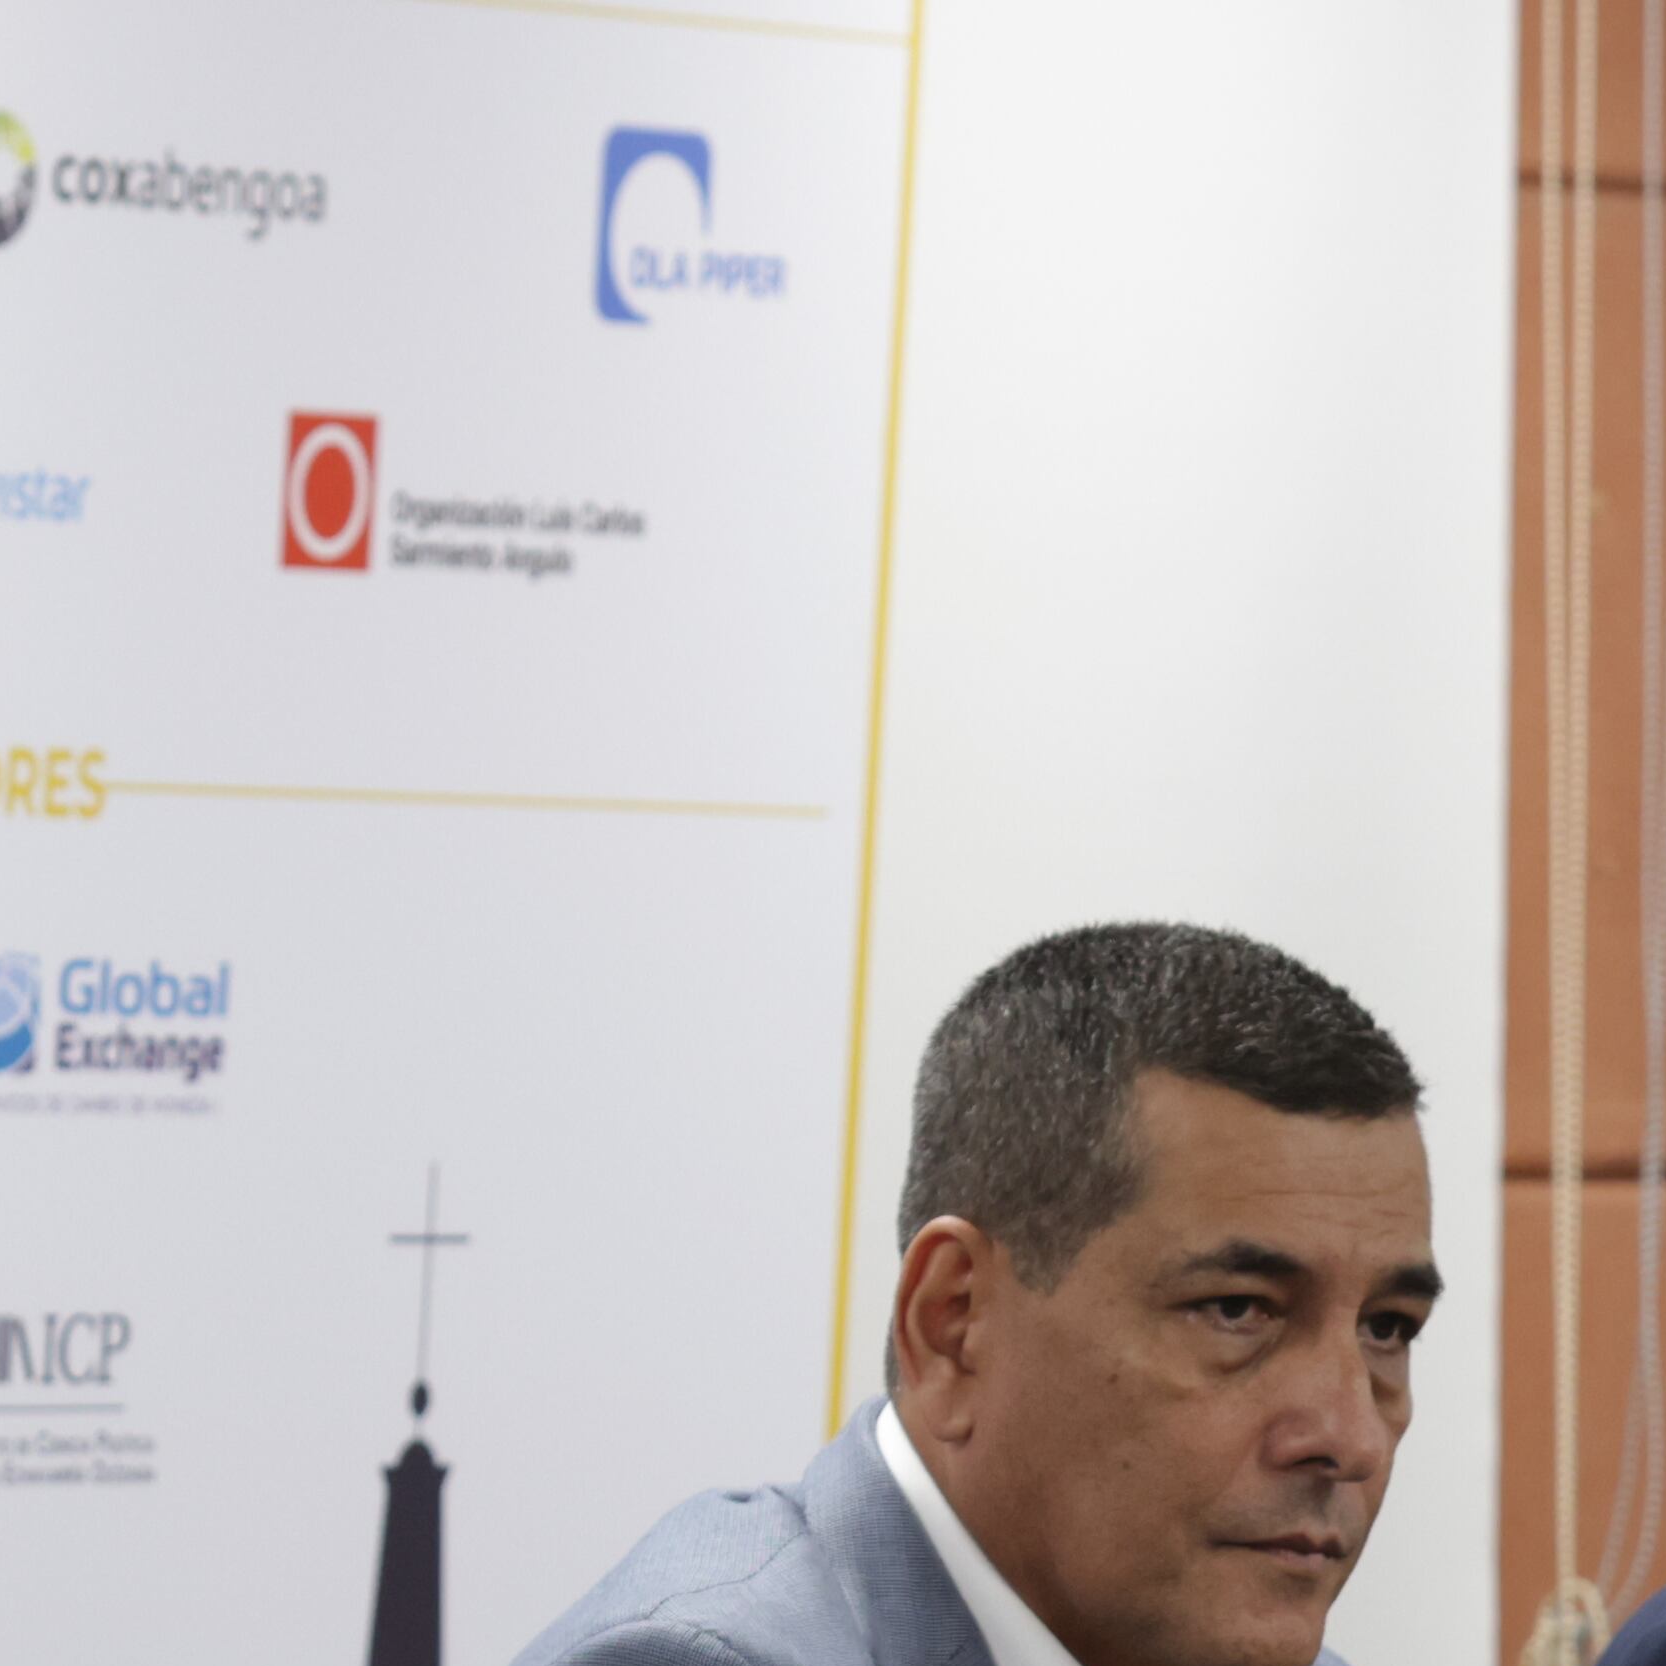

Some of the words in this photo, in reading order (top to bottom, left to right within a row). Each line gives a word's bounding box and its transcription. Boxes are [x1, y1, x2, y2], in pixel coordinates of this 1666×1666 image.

[51, 146, 327, 239] coxabengoa
[59, 958, 230, 1019] Global
[55, 1021, 224, 1083] Exchange
